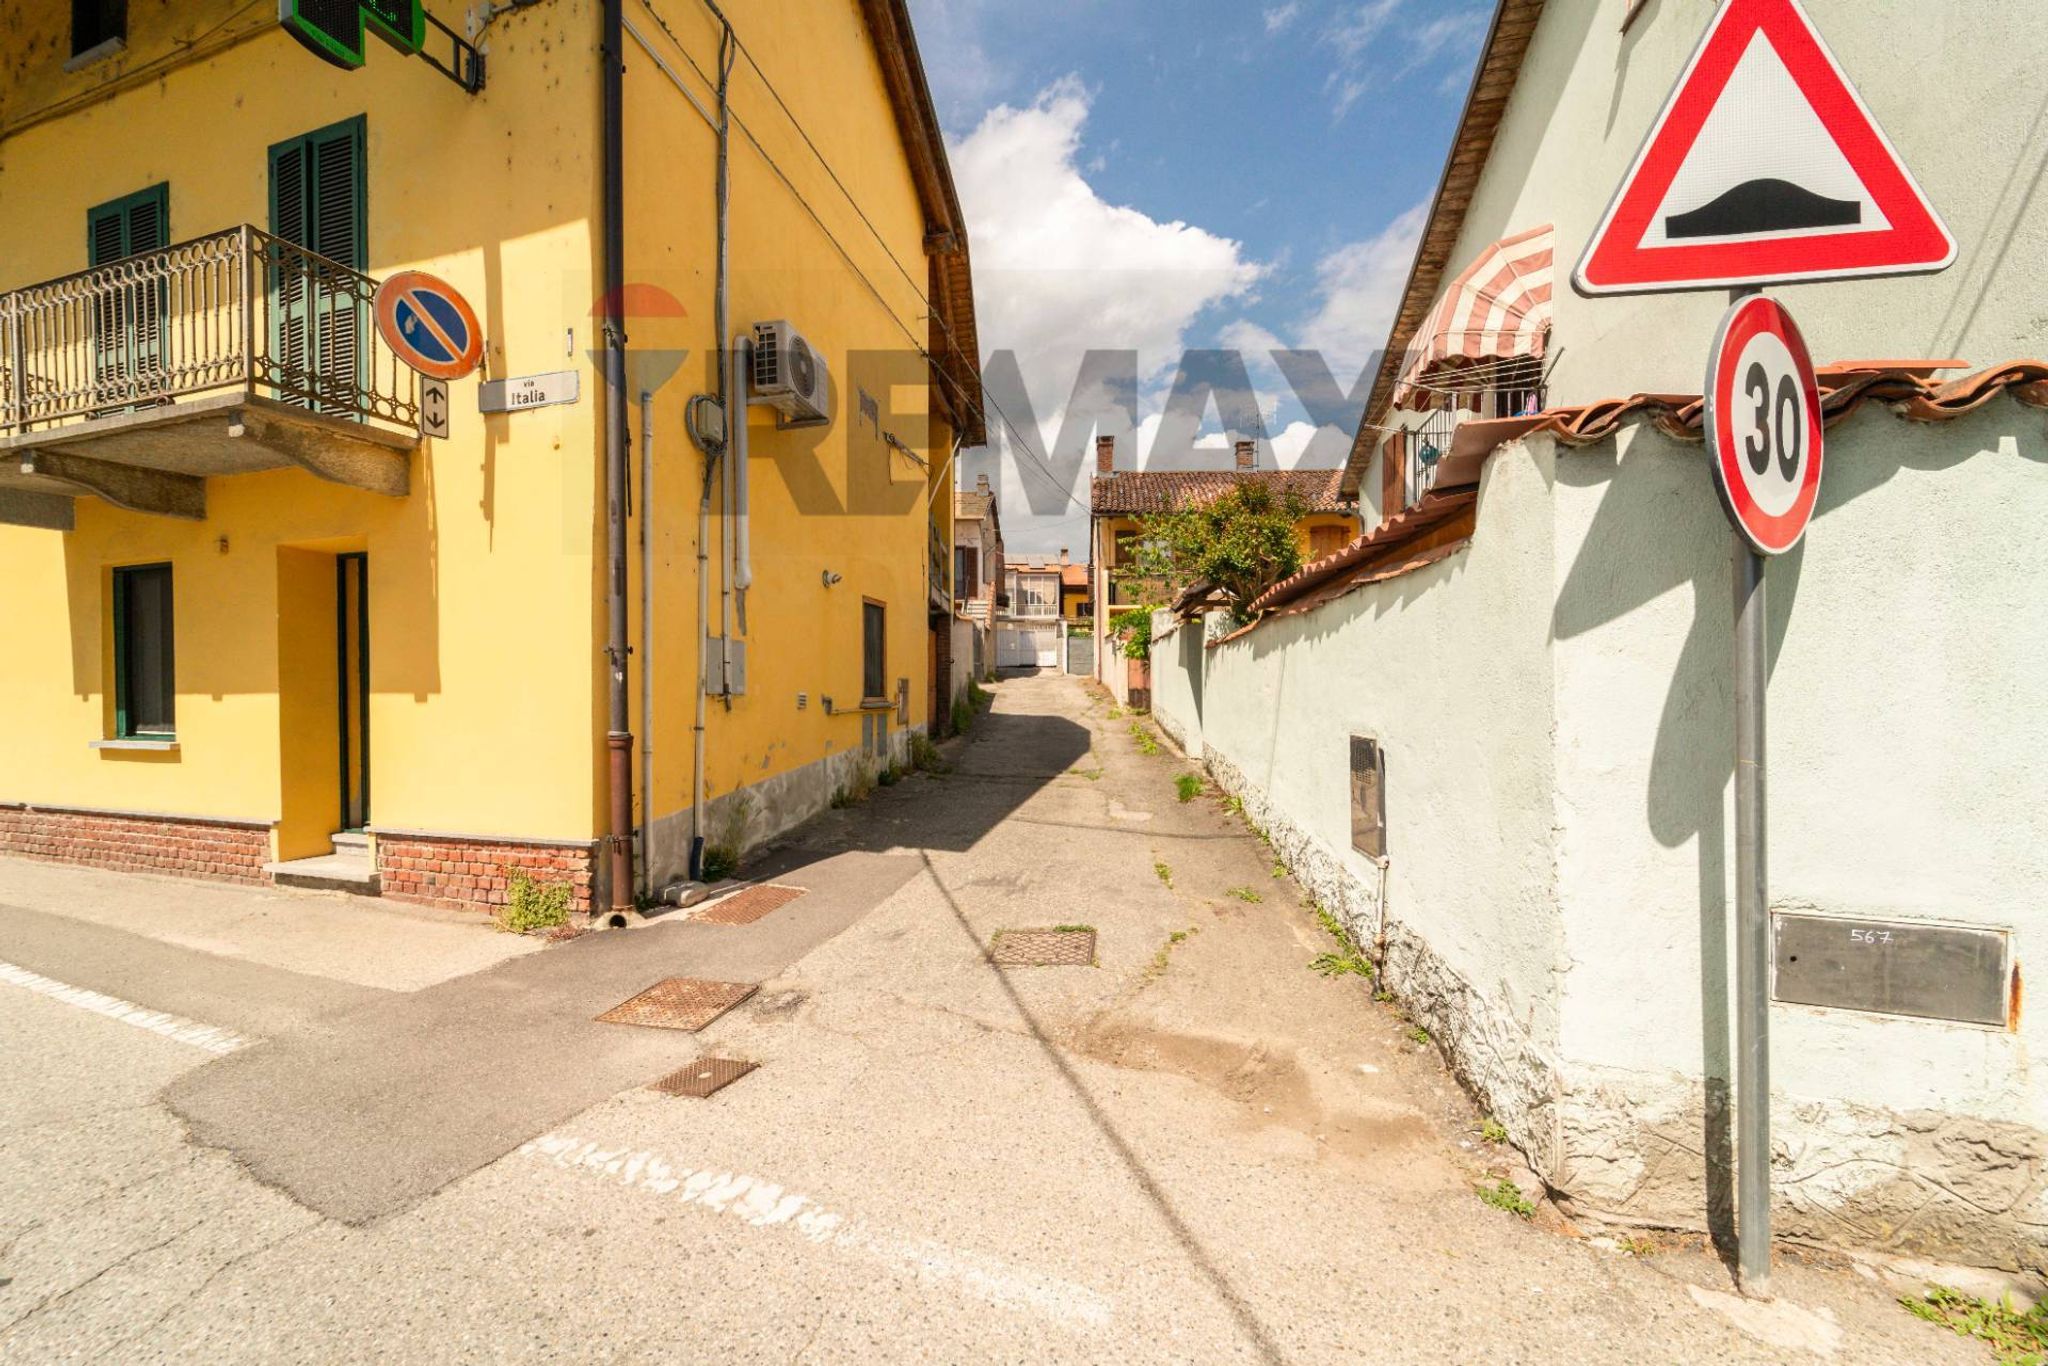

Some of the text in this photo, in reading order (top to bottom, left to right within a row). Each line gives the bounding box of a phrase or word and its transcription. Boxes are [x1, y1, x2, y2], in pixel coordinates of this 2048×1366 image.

[523, 380, 535, 388] via
[511, 390, 546, 405] Italia
[1745, 362, 1801, 482] 30
[1850, 929, 1894, 944] 567
